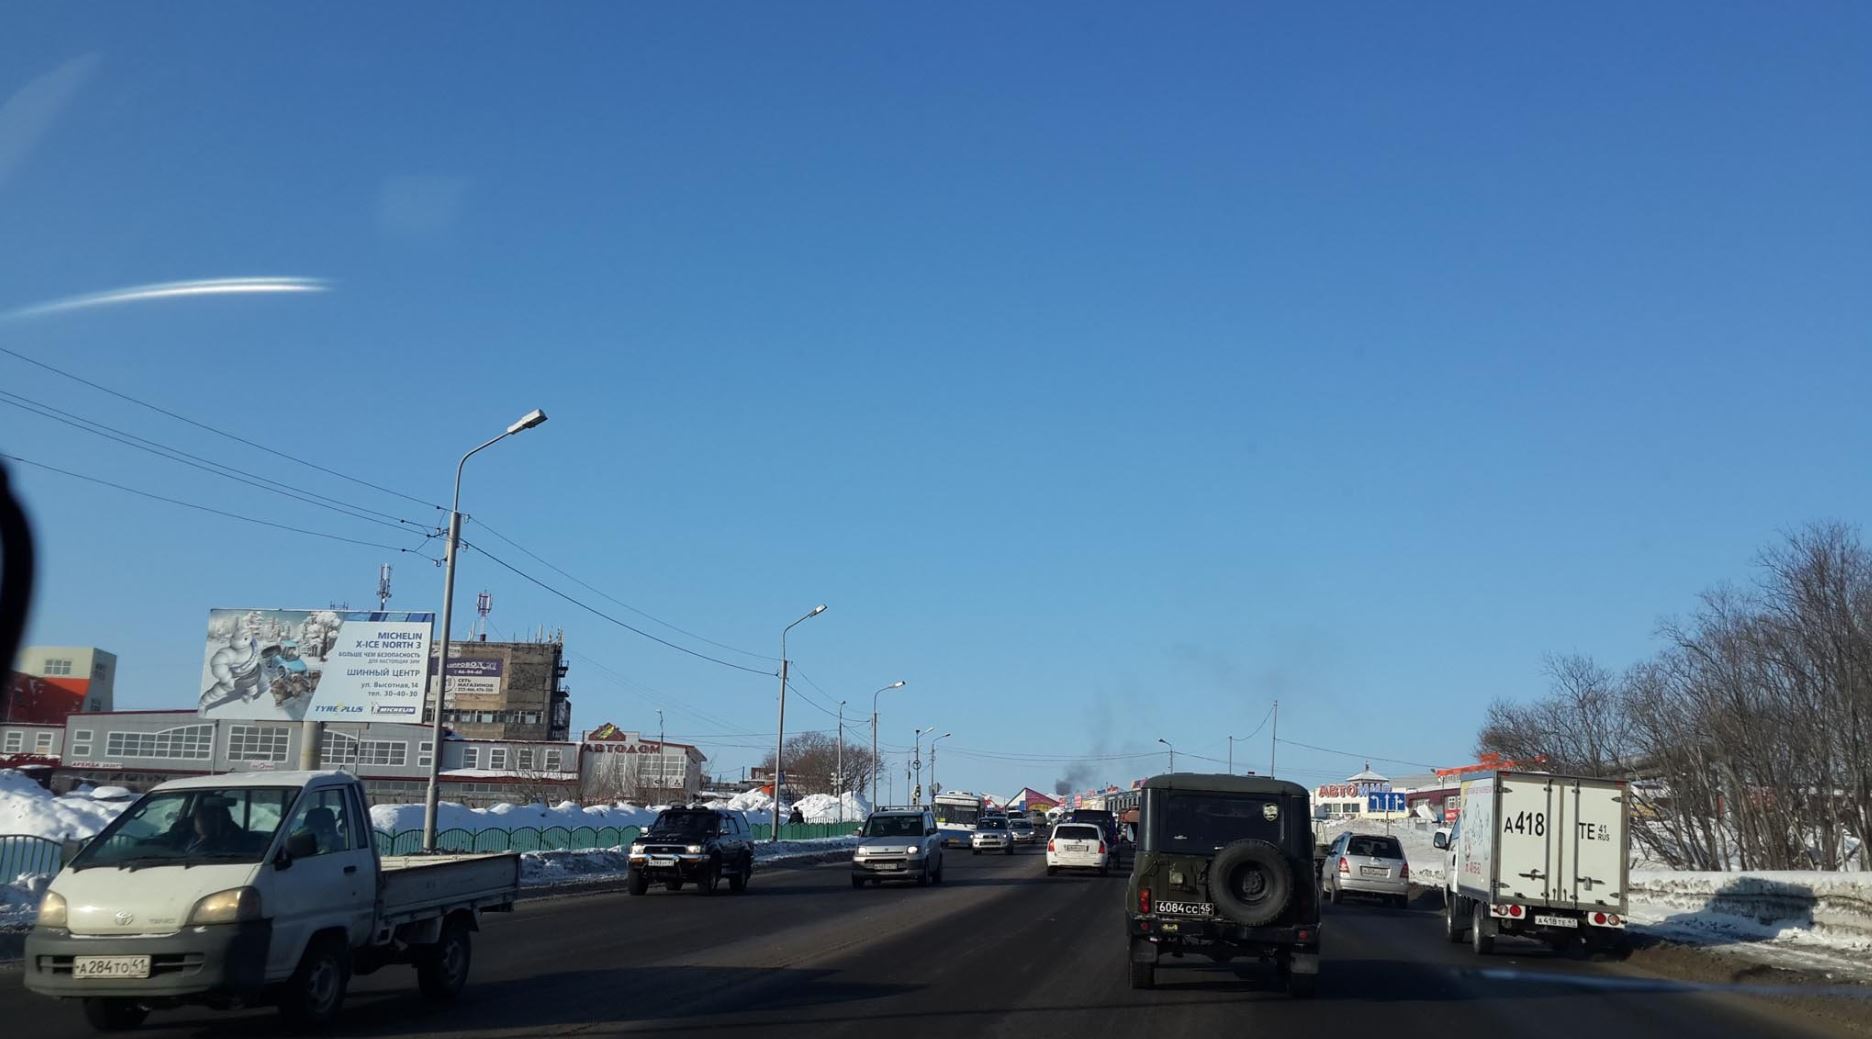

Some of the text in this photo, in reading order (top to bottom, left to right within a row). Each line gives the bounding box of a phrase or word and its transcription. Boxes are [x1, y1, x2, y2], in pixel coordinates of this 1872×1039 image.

[377, 632, 422, 640] MICHELIN
[355, 640, 380, 648] X-ICE
[382, 641, 413, 649] NORTH
[346, 667, 421, 677] ШИННЫЙ ЦЕНТР
[582, 743, 661, 754] АВТОДОМ
[1503, 810, 1545, 837] А418
